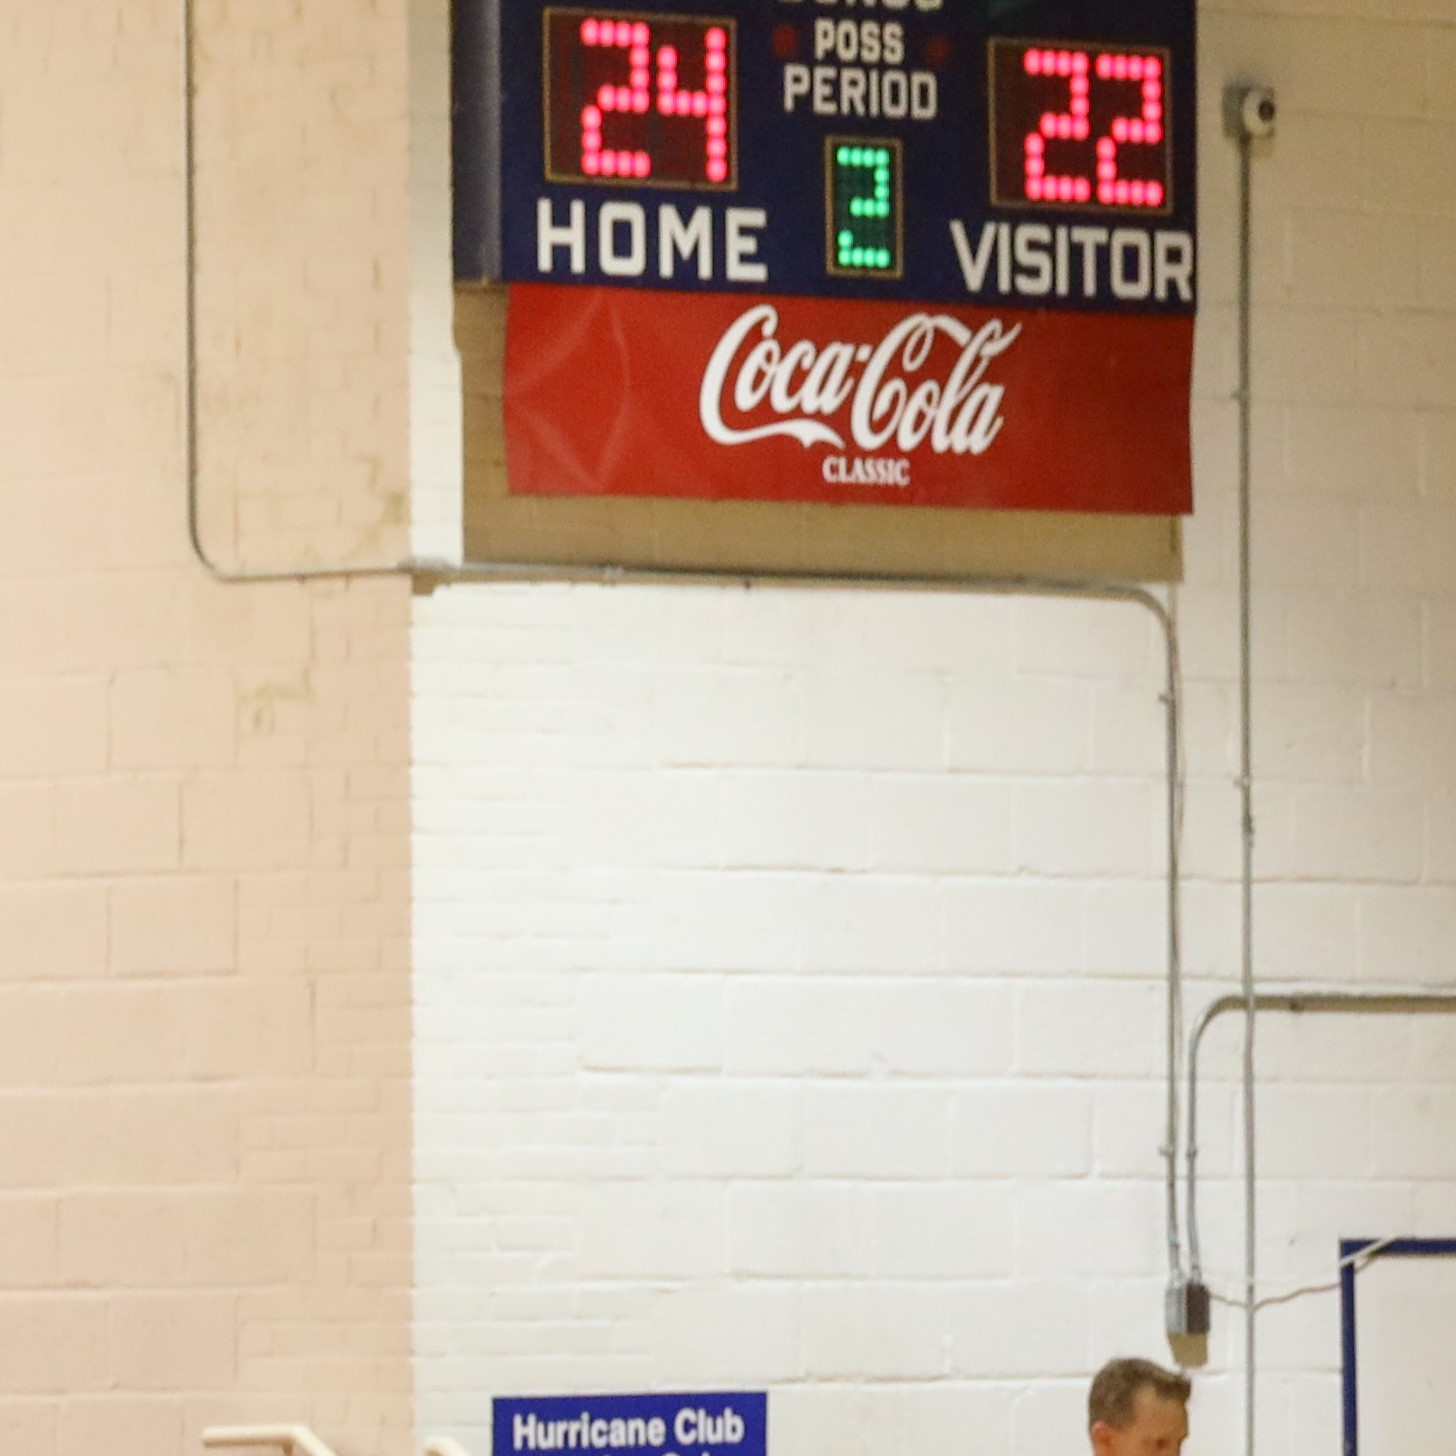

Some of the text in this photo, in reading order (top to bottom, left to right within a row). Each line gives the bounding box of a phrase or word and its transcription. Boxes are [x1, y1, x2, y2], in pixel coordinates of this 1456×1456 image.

[814, 17, 905, 65] POSS
[581, 18, 726, 183] 24
[783, 62, 938, 120] PERIOD
[1023, 48, 1163, 207] 22
[536, 197, 769, 283] HOME
[836, 145, 890, 269] 2
[950, 219, 1194, 301] VISITOR
[699, 303, 1022, 456] Coca-Cola
[821, 455, 911, 487] CLASSIC
[512, 1406, 746, 1450] Hurricane Club
